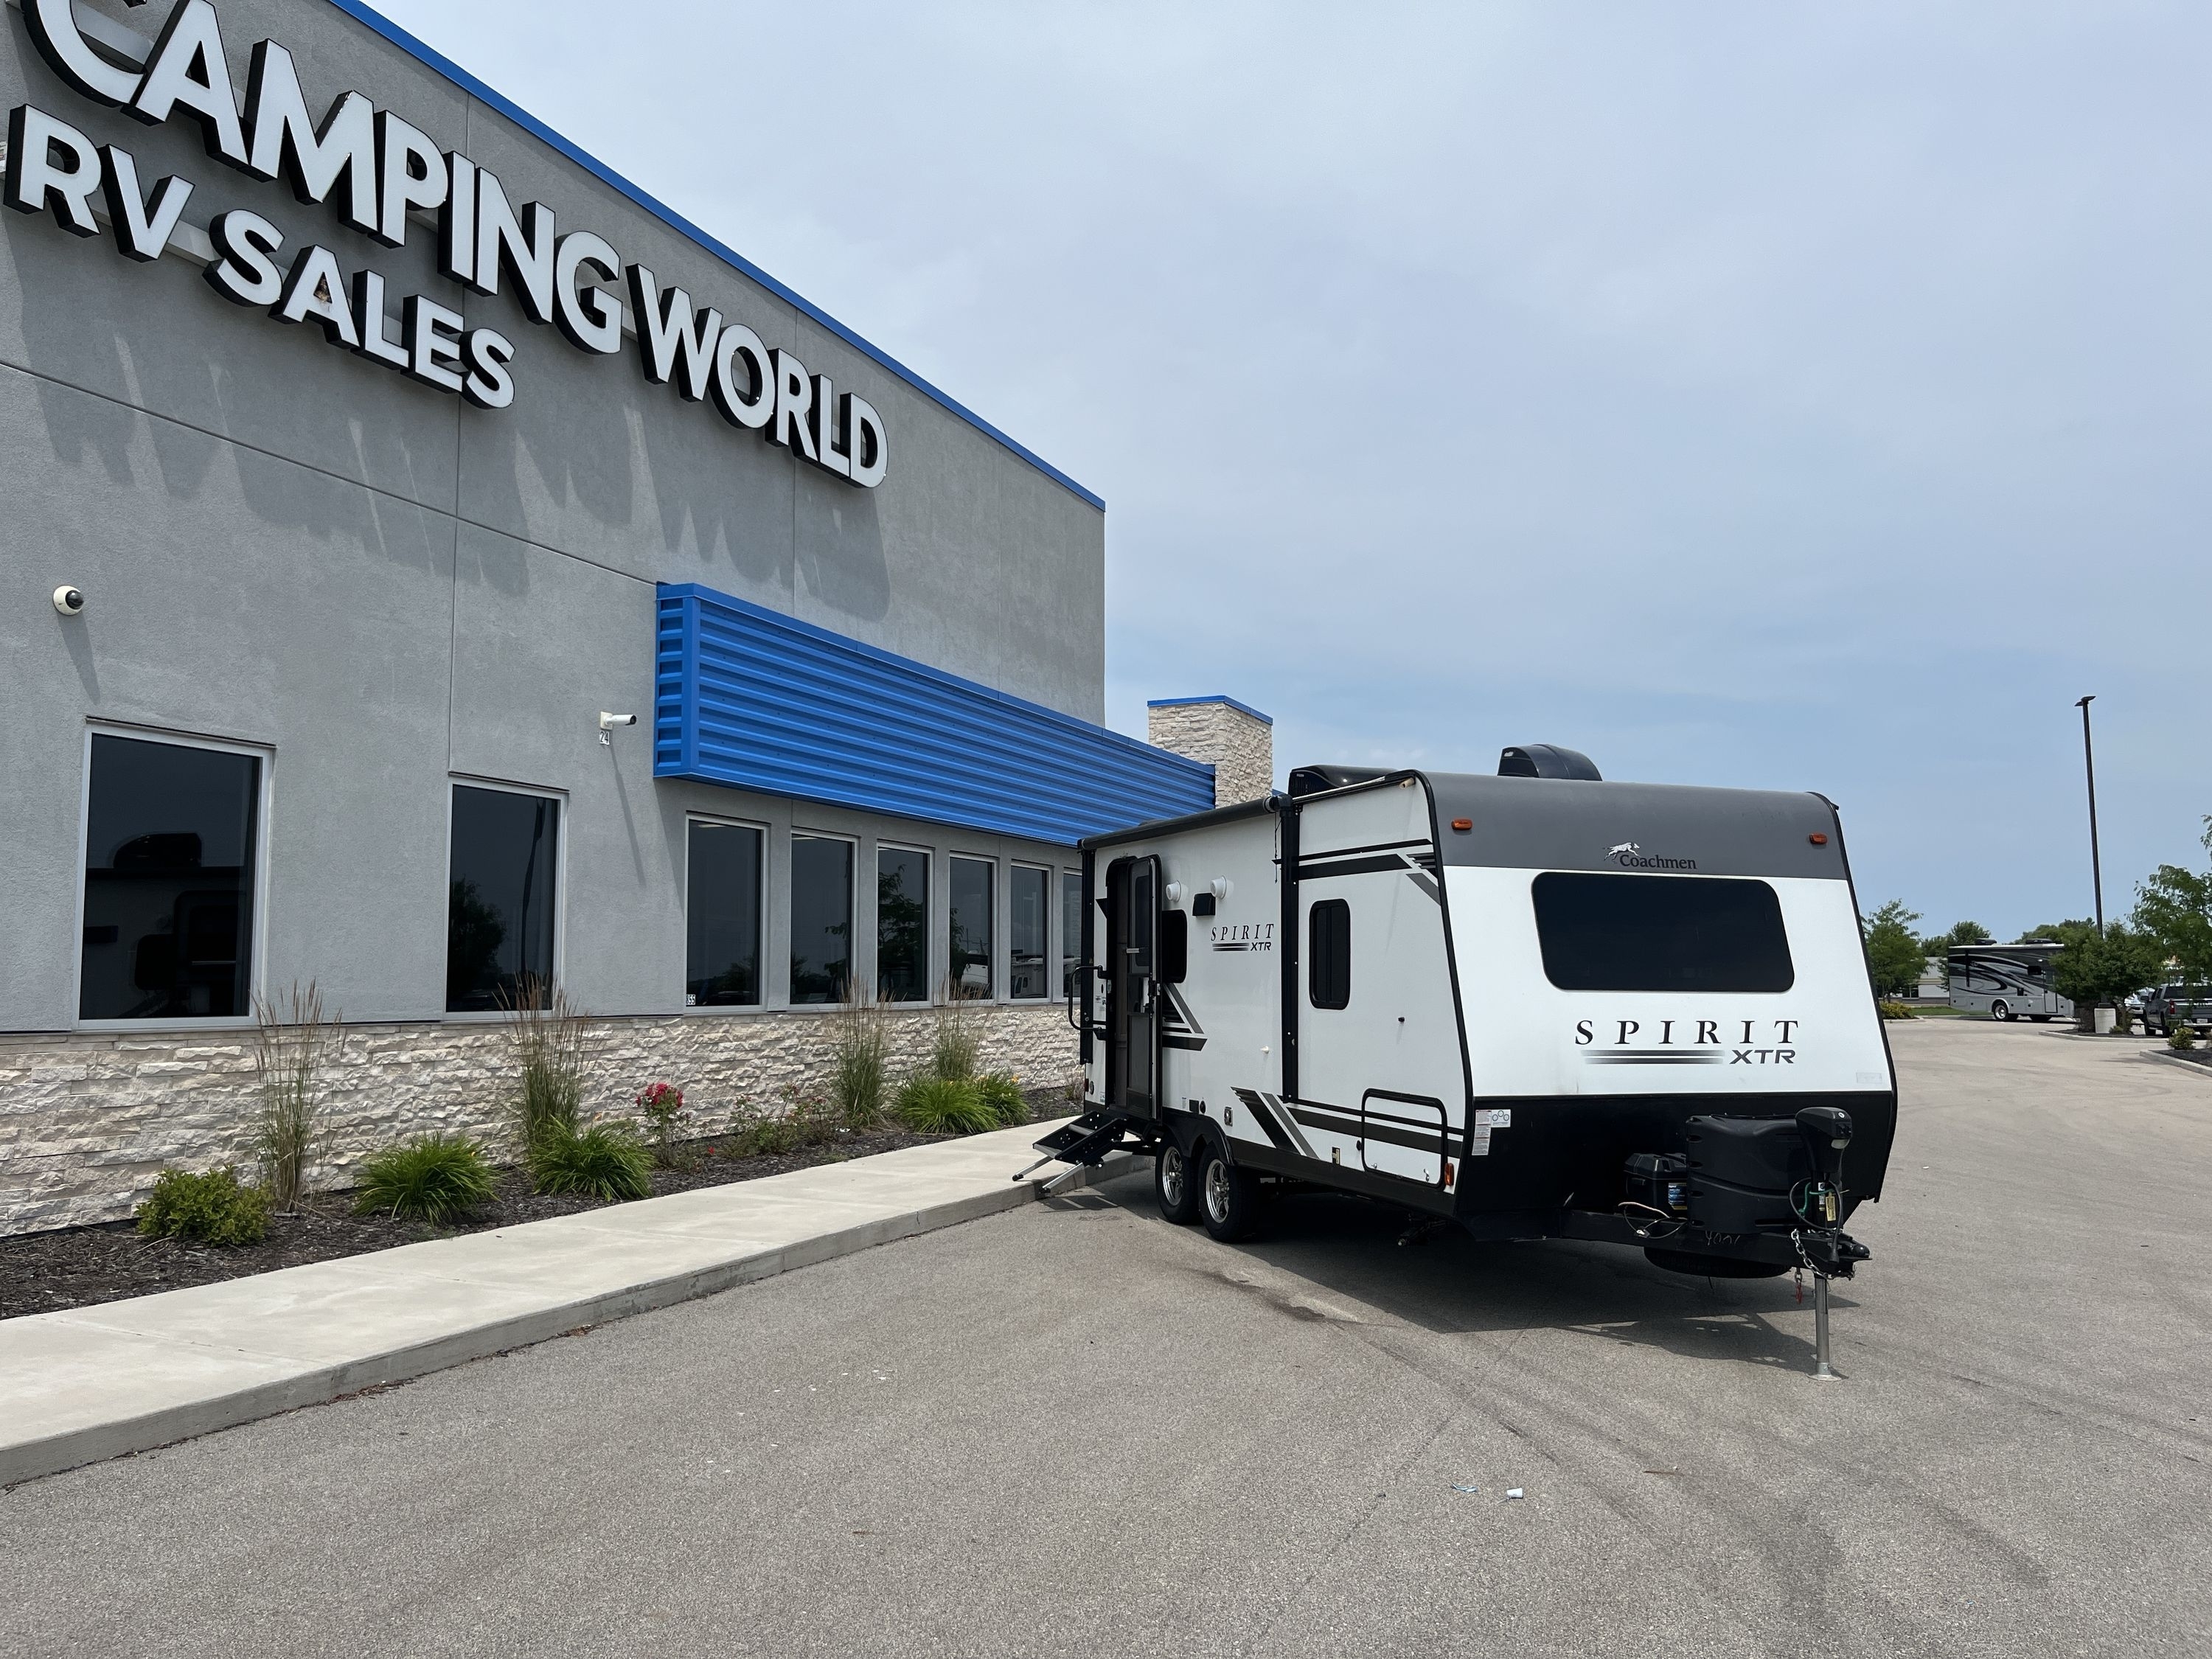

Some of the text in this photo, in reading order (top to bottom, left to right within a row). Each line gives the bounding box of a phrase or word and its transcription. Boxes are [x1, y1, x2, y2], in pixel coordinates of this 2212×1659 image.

[22, 0, 888, 488] CAMPING WORLD
[4, 104, 515, 409] RV SALES
[600, 731, 609, 744] 24
[1619, 855, 1697, 869] Coachmen
[1211, 923, 1274, 942] SPIRIT
[1251, 942, 1272, 951] XTR
[1575, 1020, 1798, 1046] SPIRIT
[1729, 1049, 1796, 1065] XTR
